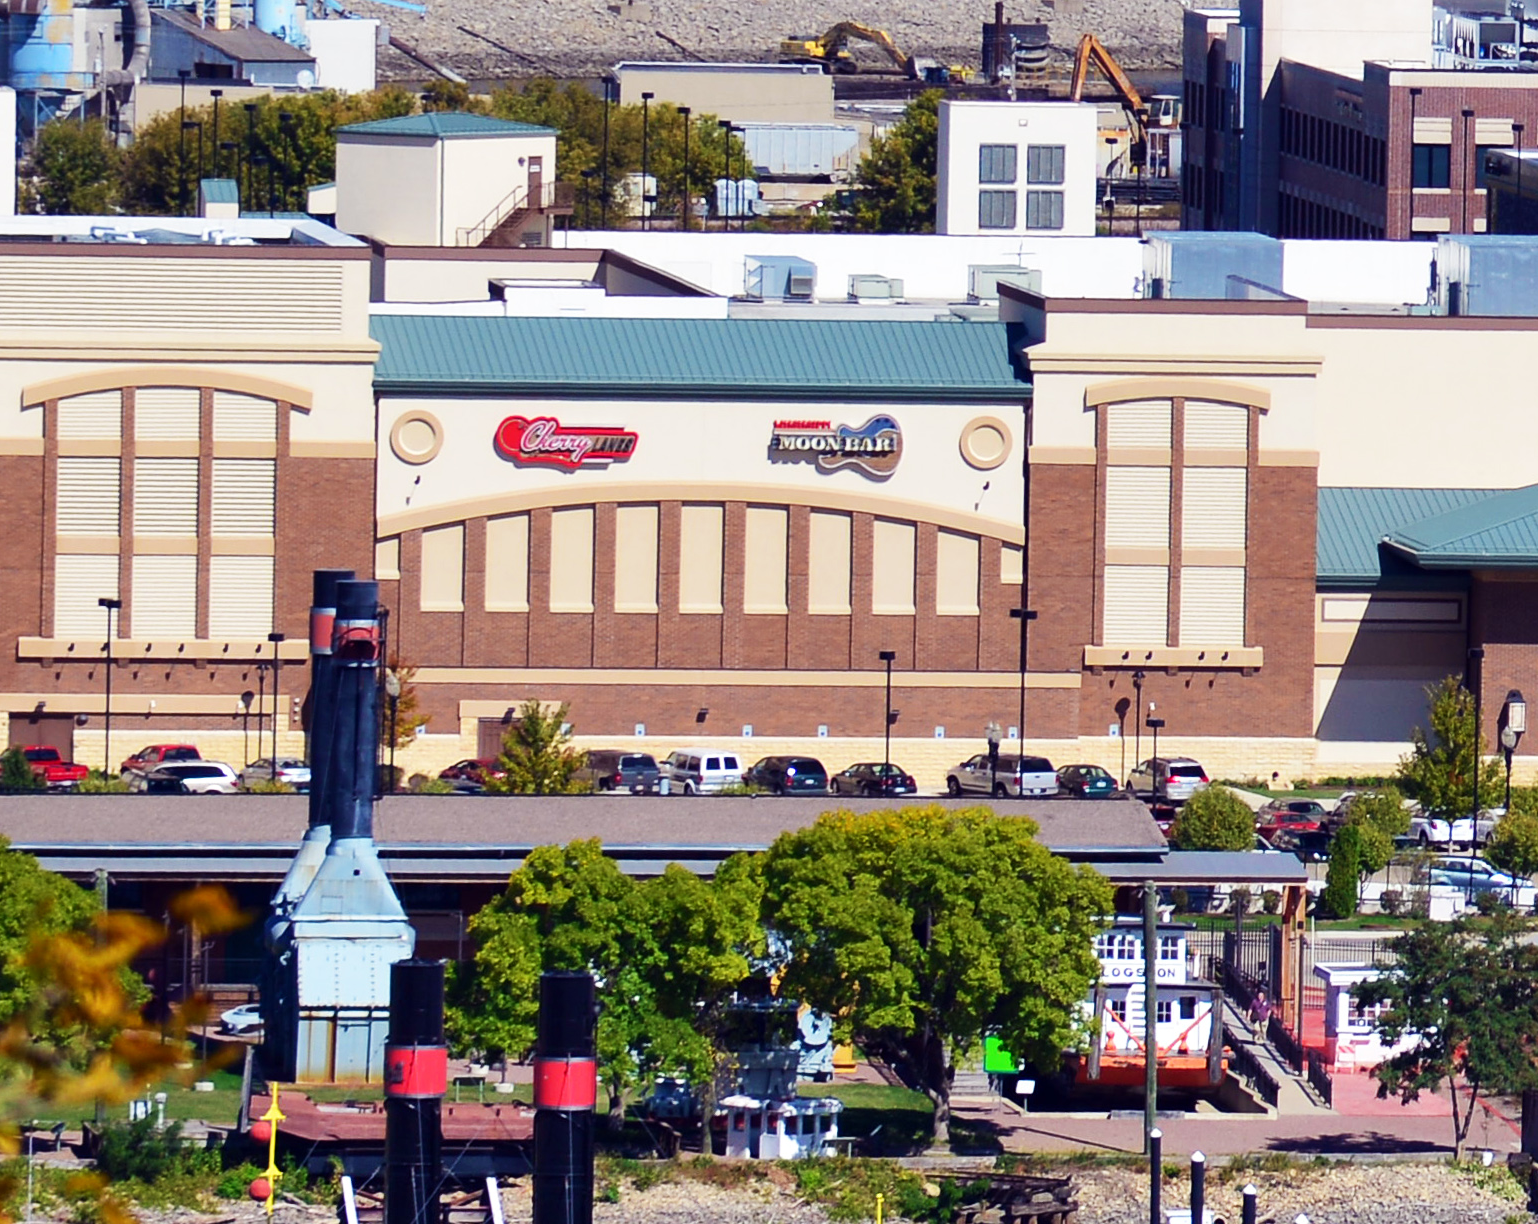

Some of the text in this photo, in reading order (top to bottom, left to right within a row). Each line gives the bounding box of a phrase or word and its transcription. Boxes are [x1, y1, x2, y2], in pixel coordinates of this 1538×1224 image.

[521, 420, 593, 462] Cherry
[778, 436, 891, 451] MOON BAR
[1102, 967, 1175, 978] LOGSON
